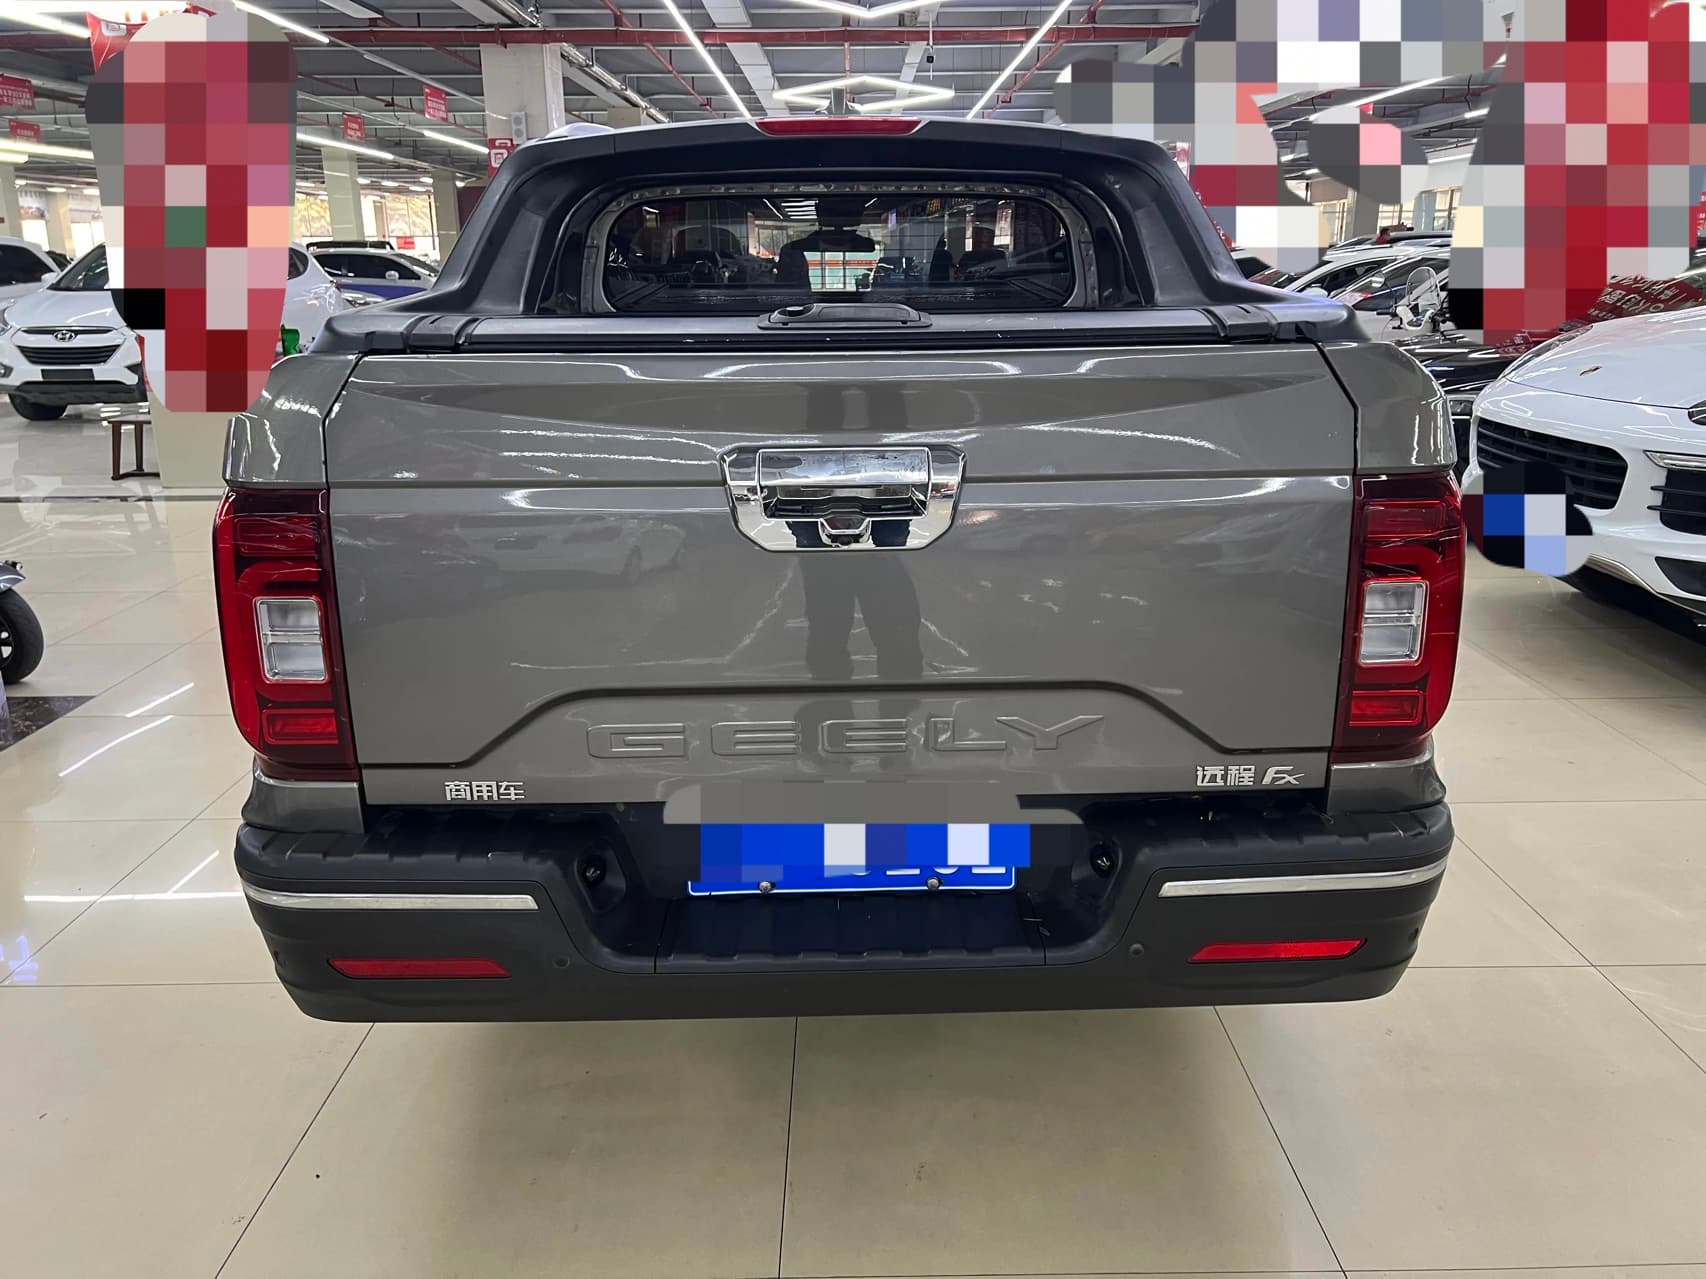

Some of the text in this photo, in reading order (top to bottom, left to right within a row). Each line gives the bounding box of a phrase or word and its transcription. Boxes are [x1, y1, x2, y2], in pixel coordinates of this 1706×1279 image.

[587, 715, 1105, 758] GEELY
[1196, 765, 1256, 787] 远程
[444, 780, 525, 801] 商用车
